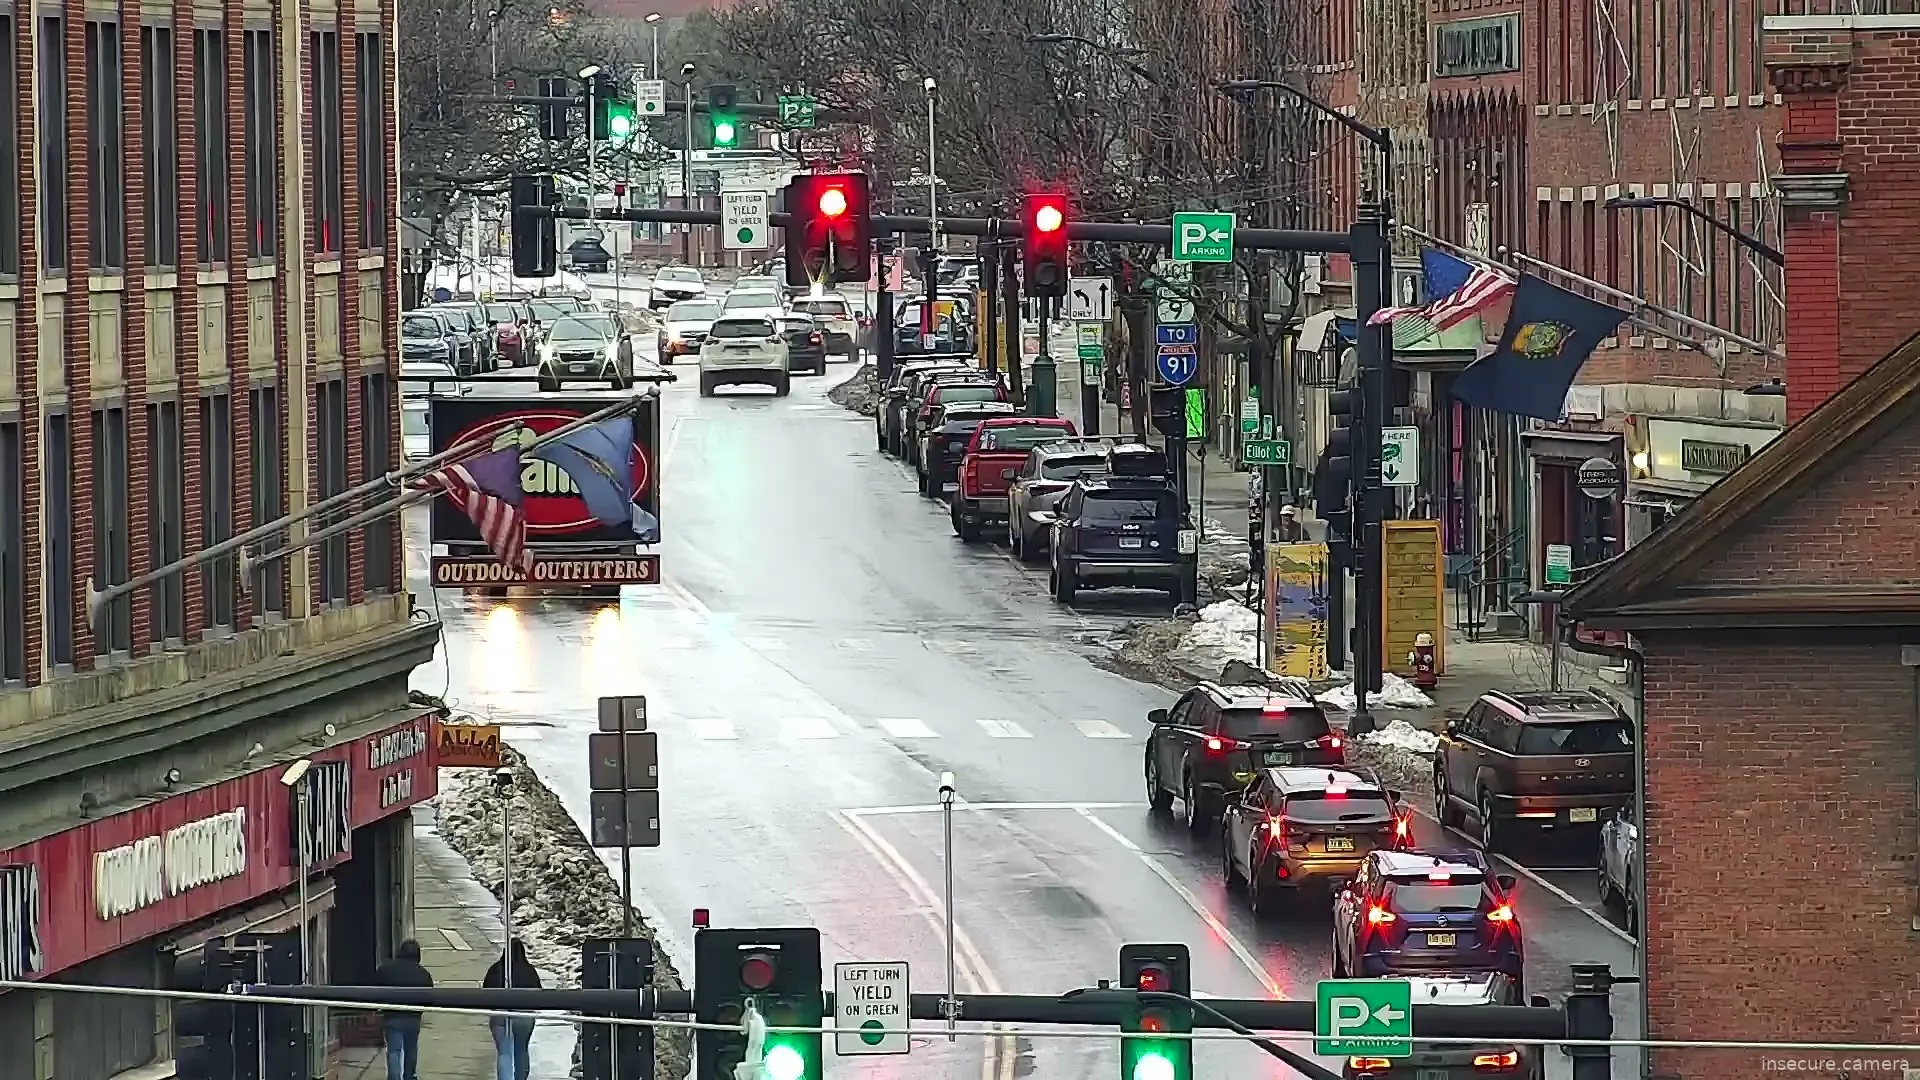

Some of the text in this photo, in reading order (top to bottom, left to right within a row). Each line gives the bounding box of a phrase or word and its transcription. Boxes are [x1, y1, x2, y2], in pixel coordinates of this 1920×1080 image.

[733, 205, 758, 216] YIELD
[1072, 310, 1092, 318] ONLY
[1169, 301, 1183, 320] 9
[1166, 328, 1186, 340] TO
[1167, 356, 1188, 375] 91
[1388, 432, 1411, 440] HERE
[1246, 445, 1287, 460] Elliot St
[534, 560, 649, 581] OUTFITTERS
[304, 760, 349, 867] SAM'S
[844, 969, 900, 981] LEFT TURN
[853, 985, 892, 1001] YIELD
[845, 1004, 899, 1016] ON GREEN
